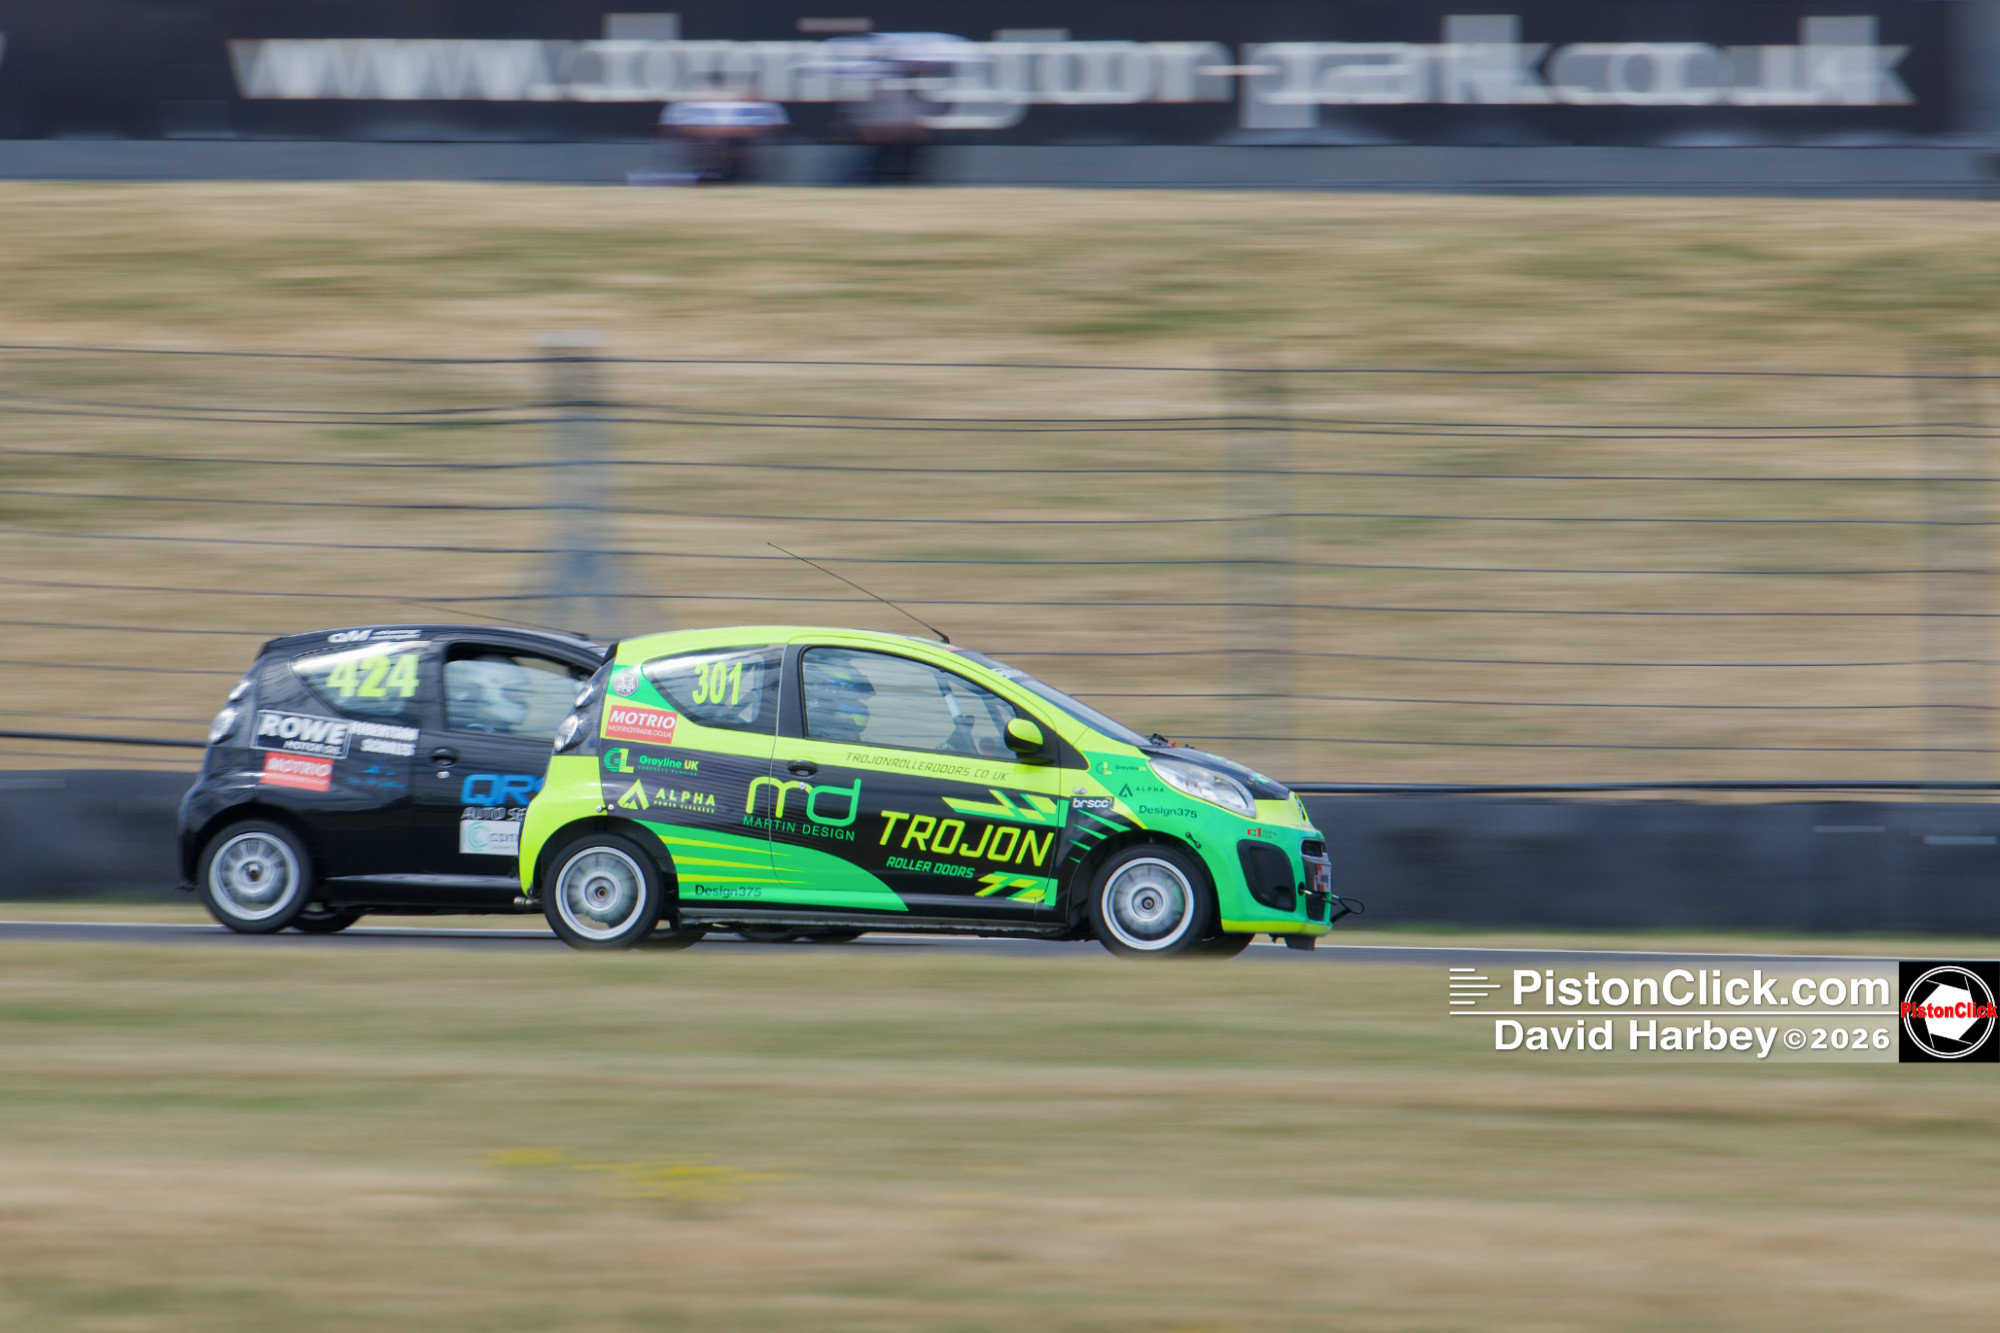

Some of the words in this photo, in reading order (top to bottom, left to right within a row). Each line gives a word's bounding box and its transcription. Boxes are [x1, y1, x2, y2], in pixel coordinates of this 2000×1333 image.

[326, 654, 420, 698] 424
[692, 662, 742, 705] 301
[609, 710, 676, 729] MOTRIO
[258, 714, 347, 746] ROWE
[264, 758, 332, 777] MOTRIO
[639, 755, 682, 768] Greyline
[684, 760, 699, 771] UK
[655, 788, 716, 806] ALPHA
[1072, 798, 1108, 808] brscc
[461, 807, 507, 820] AUTO
[1138, 805, 1198, 819] Design375
[743, 815, 796, 833] MARTIN
[802, 824, 855, 842] DESIGN
[880, 810, 1055, 867] TROJON
[886, 856, 932, 873] ROLLER
[933, 862, 976, 879] DOORS
[695, 884, 762, 898] Design375
